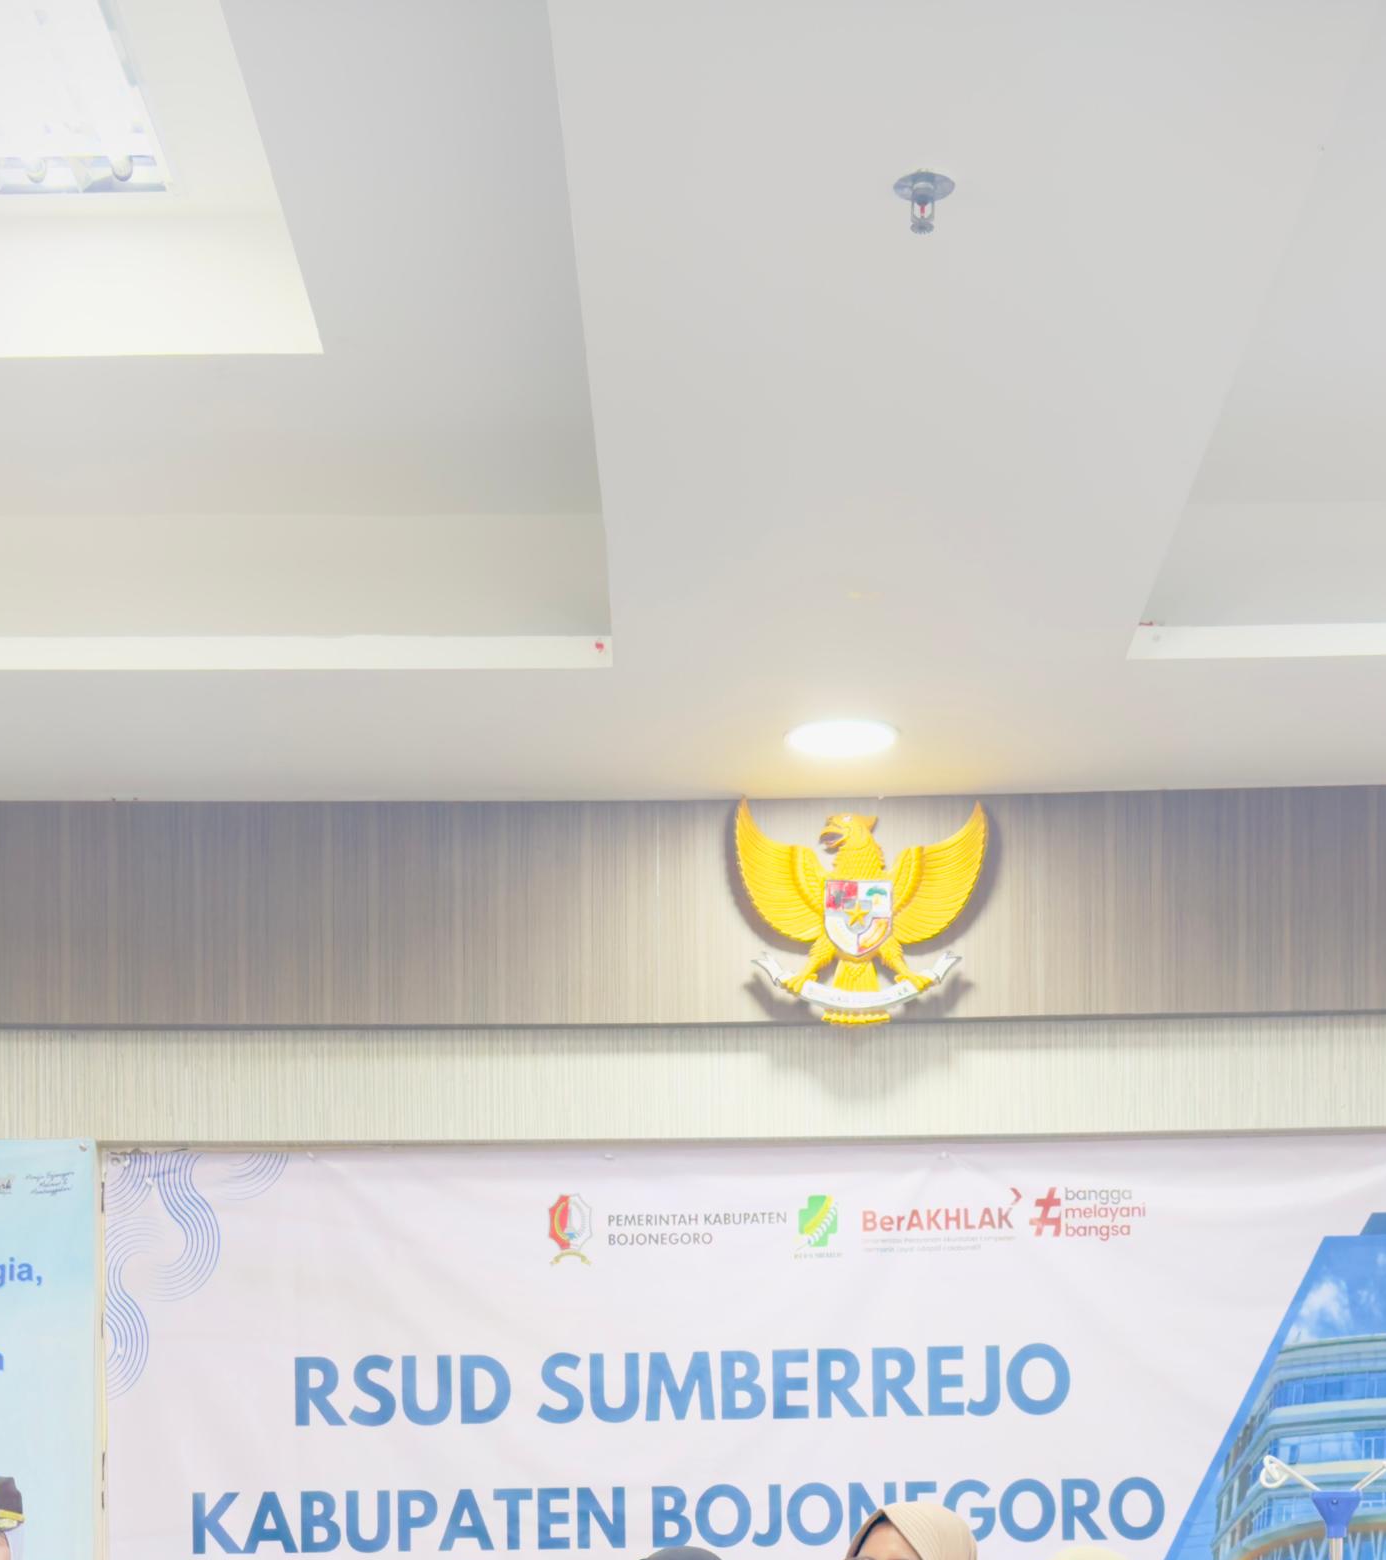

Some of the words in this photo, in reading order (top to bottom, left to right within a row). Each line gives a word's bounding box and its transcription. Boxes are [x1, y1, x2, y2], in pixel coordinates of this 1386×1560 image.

[1064, 1186, 1133, 1205] bangga
[607, 1213, 699, 1228] PEMERINTAH
[703, 1211, 788, 1226] KABUPATEN
[861, 1206, 1015, 1232] BerAKHLAK
[1064, 1202, 1147, 1223] melayani
[607, 1232, 714, 1247] BOJONEGORO
[1064, 1221, 1132, 1241] bangsa
[296, 1355, 511, 1426] RSUD
[538, 1343, 1071, 1424] SUMBERREJO
[192, 1487, 626, 1554] KABUPATEN
[651, 1477, 1166, 1548] BOJONGORO
